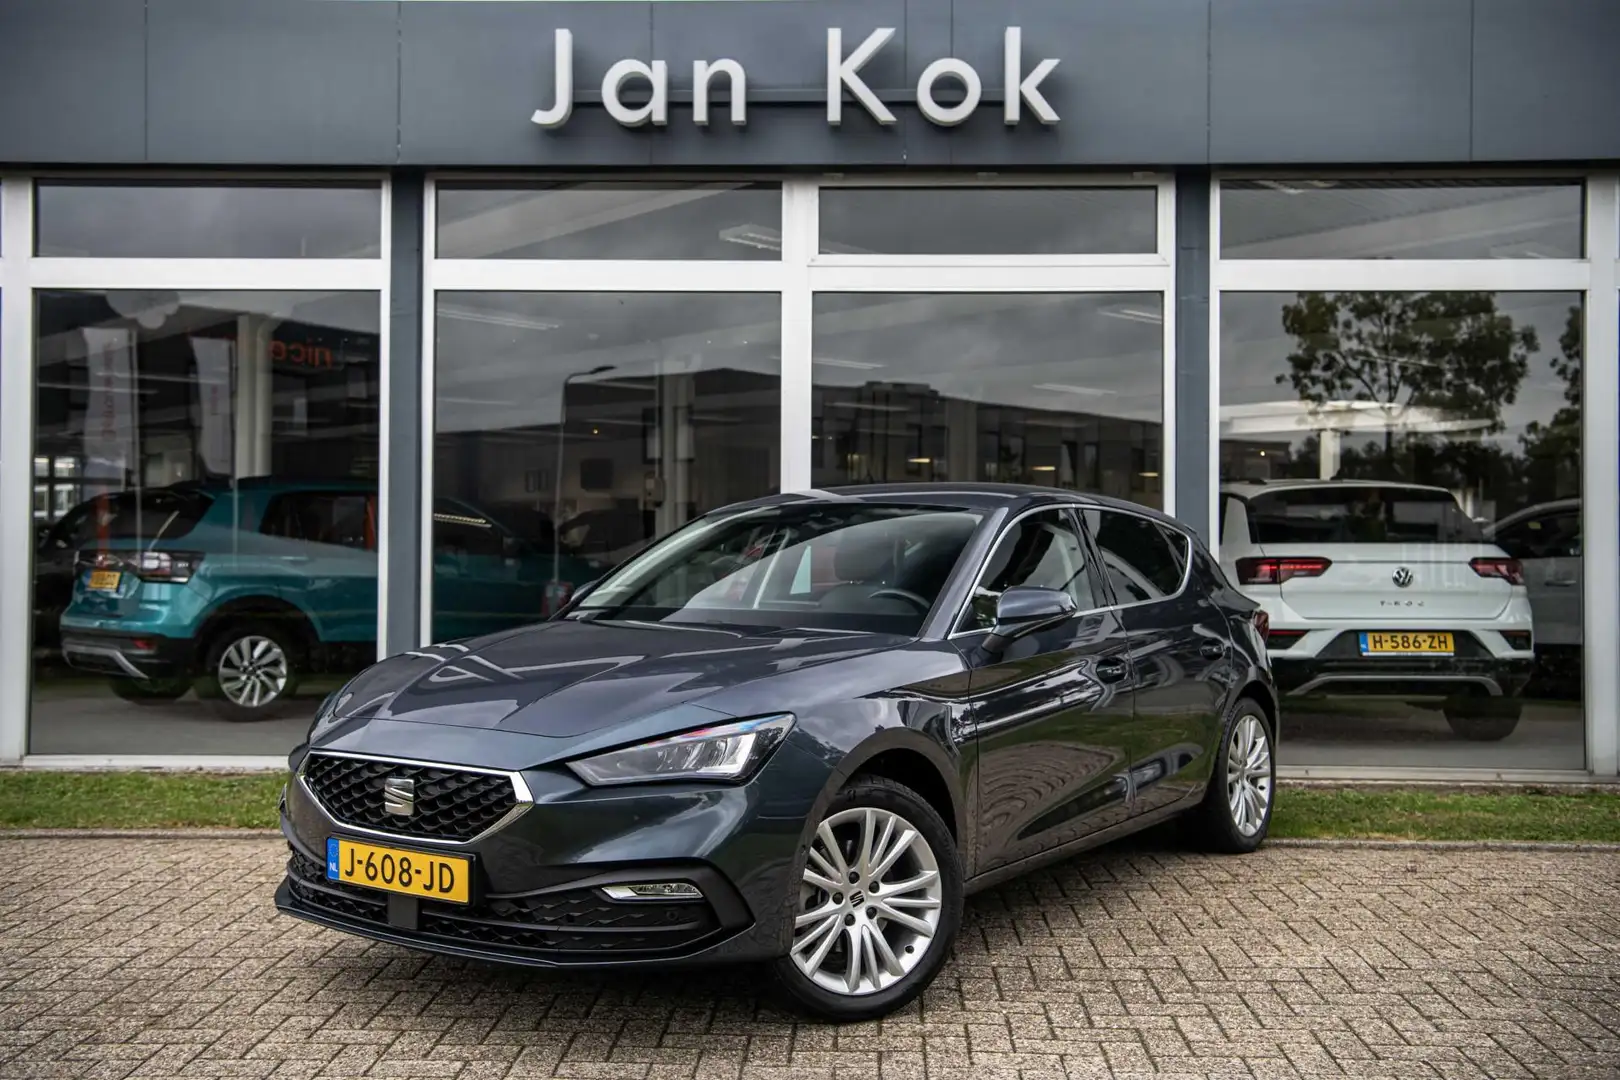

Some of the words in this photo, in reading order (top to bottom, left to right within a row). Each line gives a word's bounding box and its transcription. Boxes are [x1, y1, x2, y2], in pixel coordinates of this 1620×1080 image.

[530, 27, 747, 128] Jan
[827, 26, 1062, 128] Kok
[1372, 634, 1448, 649] H-586-ZH
[329, 861, 338, 872] NL
[344, 848, 455, 893] J-608-JD
